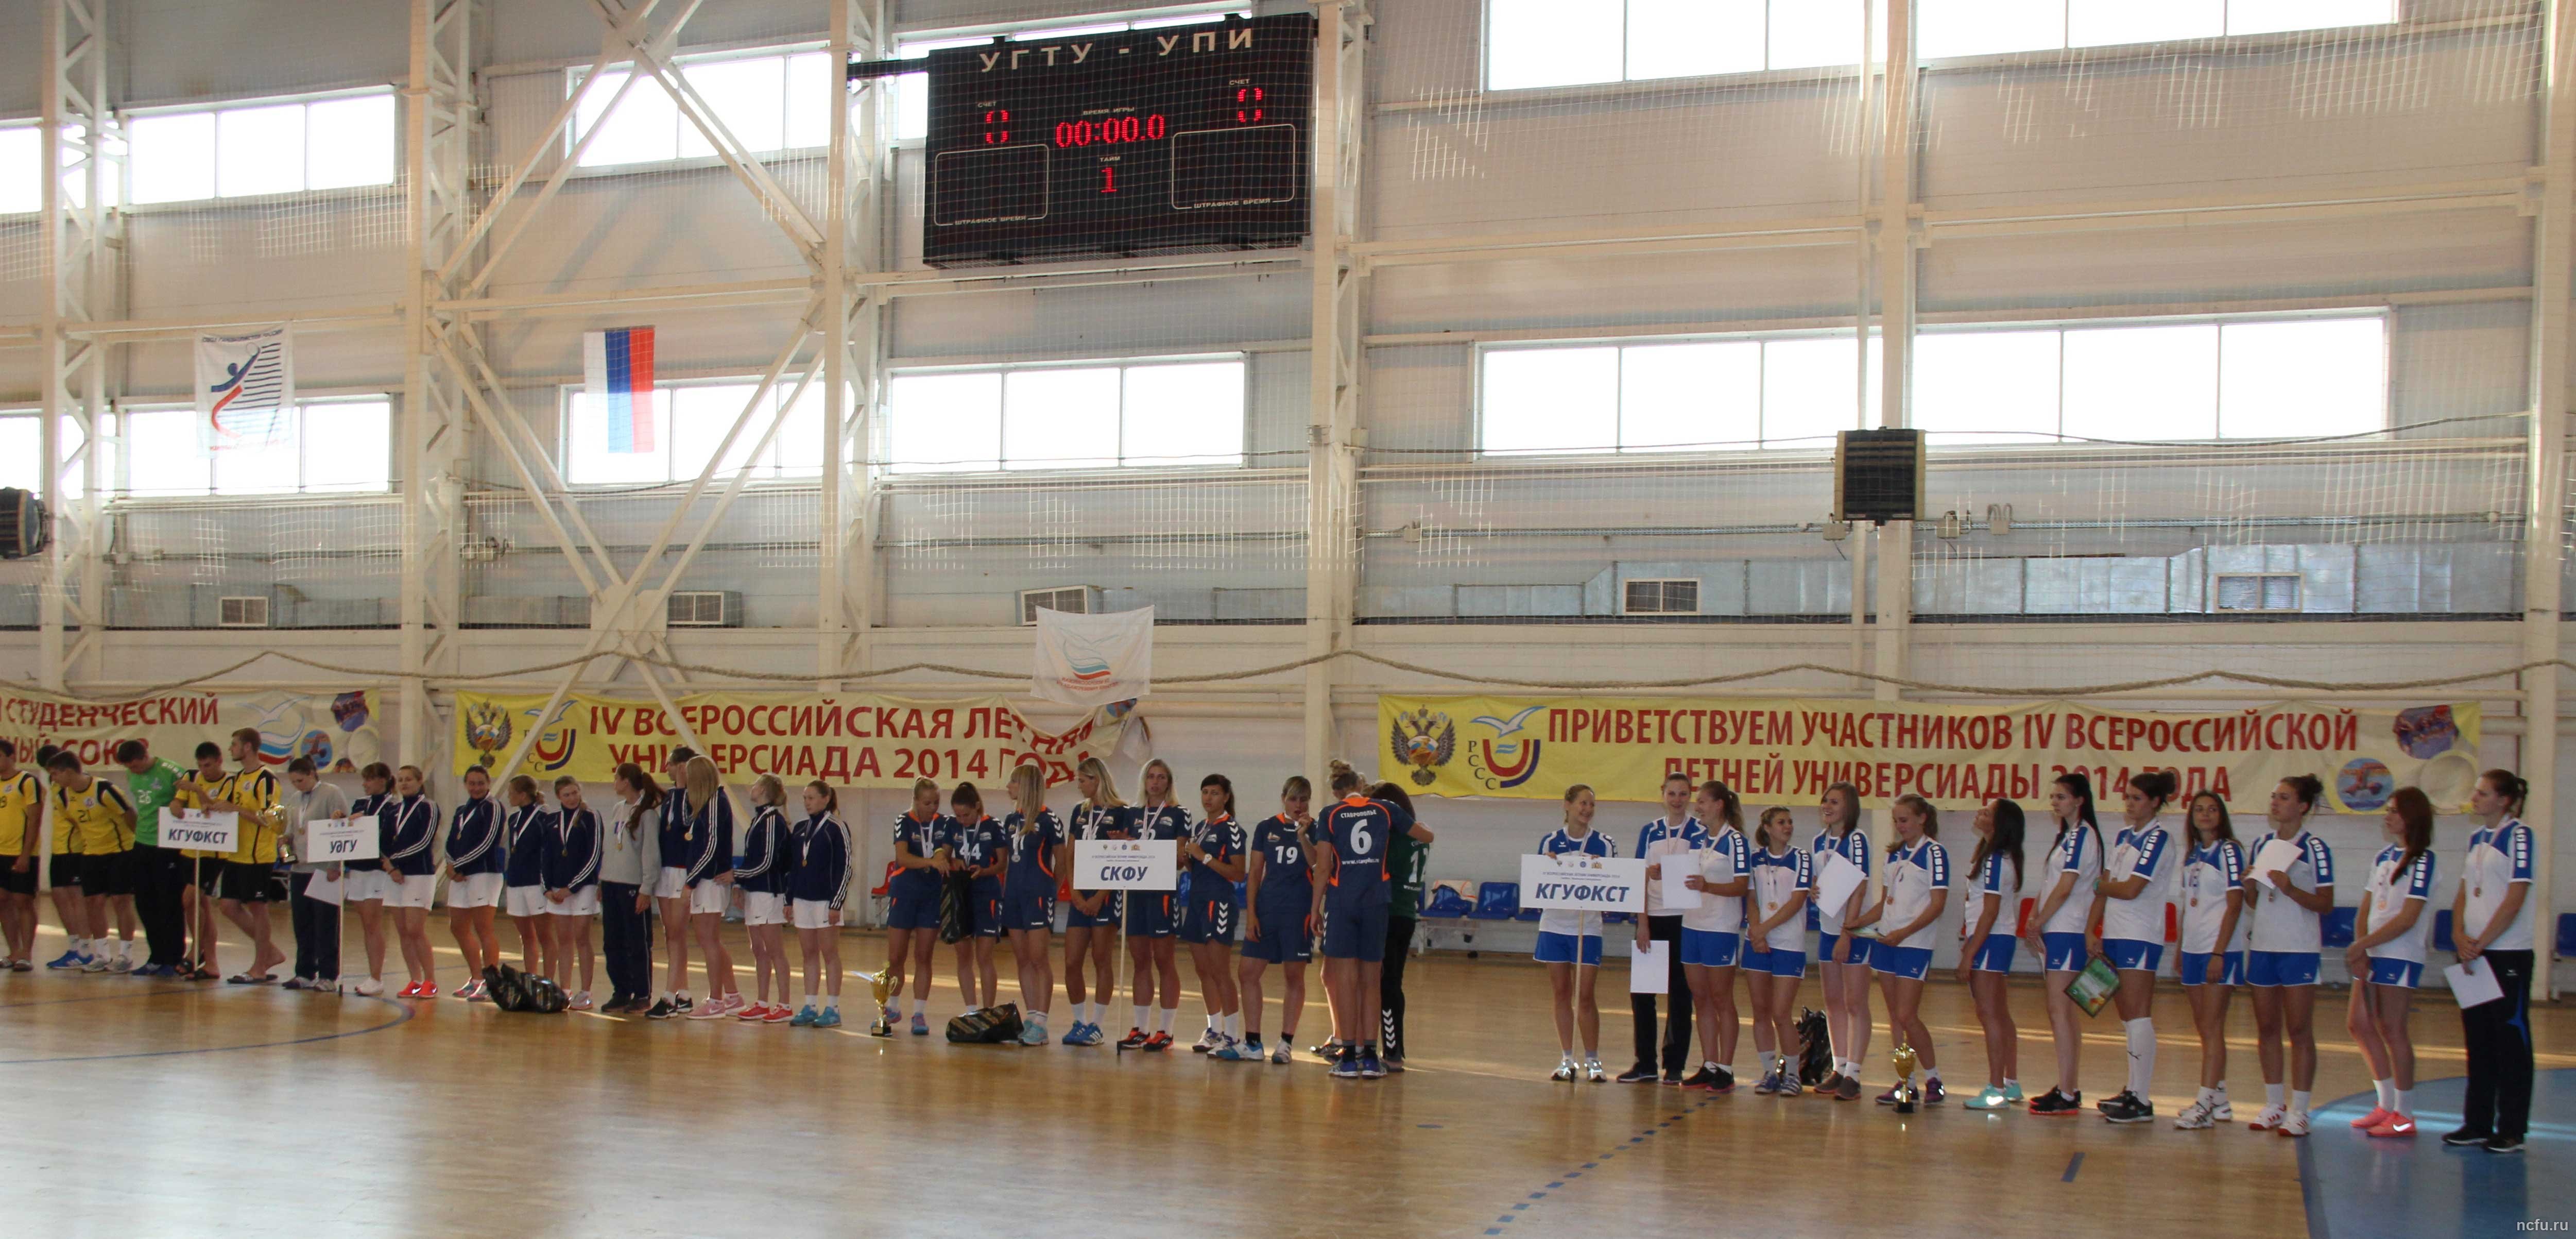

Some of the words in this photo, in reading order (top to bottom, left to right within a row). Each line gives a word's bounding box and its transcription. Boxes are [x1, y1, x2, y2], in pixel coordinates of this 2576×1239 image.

[980, 43, 1093, 72] УГТУ
[1157, 28, 1252, 56] УПИ
[1056, 114, 1165, 148] 00:00.0
[1100, 166, 1118, 193] 1
[1194, 200, 1240, 209] ШТРАФНОЕ
[955, 217, 997, 226] ШТРАФНОЕ
[6, 692, 218, 732] СТУДЕНЧЕСКИЙ
[590, 706, 625, 735] IV
[634, 699, 954, 738] ВСЕРОССИЙСКАЯ
[1549, 708, 1793, 745] ПРИВЕТСТВУЕМ
[1801, 711, 2012, 750] УЧАСТНИКОВ
[2024, 713, 2056, 749] IV
[2066, 708, 2358, 752] ВСЕРОССИЙСКОЙ
[894, 749, 989, 778] 2014
[1793, 759, 2039, 806] УНИВЕРСИАДЫ
[168, 828, 228, 844] КГУФКСТ
[1350, 819, 1372, 855] 6
[1275, 845, 1298, 864] 19
[1100, 866, 1148, 881] СКФУ
[1535, 883, 1630, 902] КГУФКСТ
